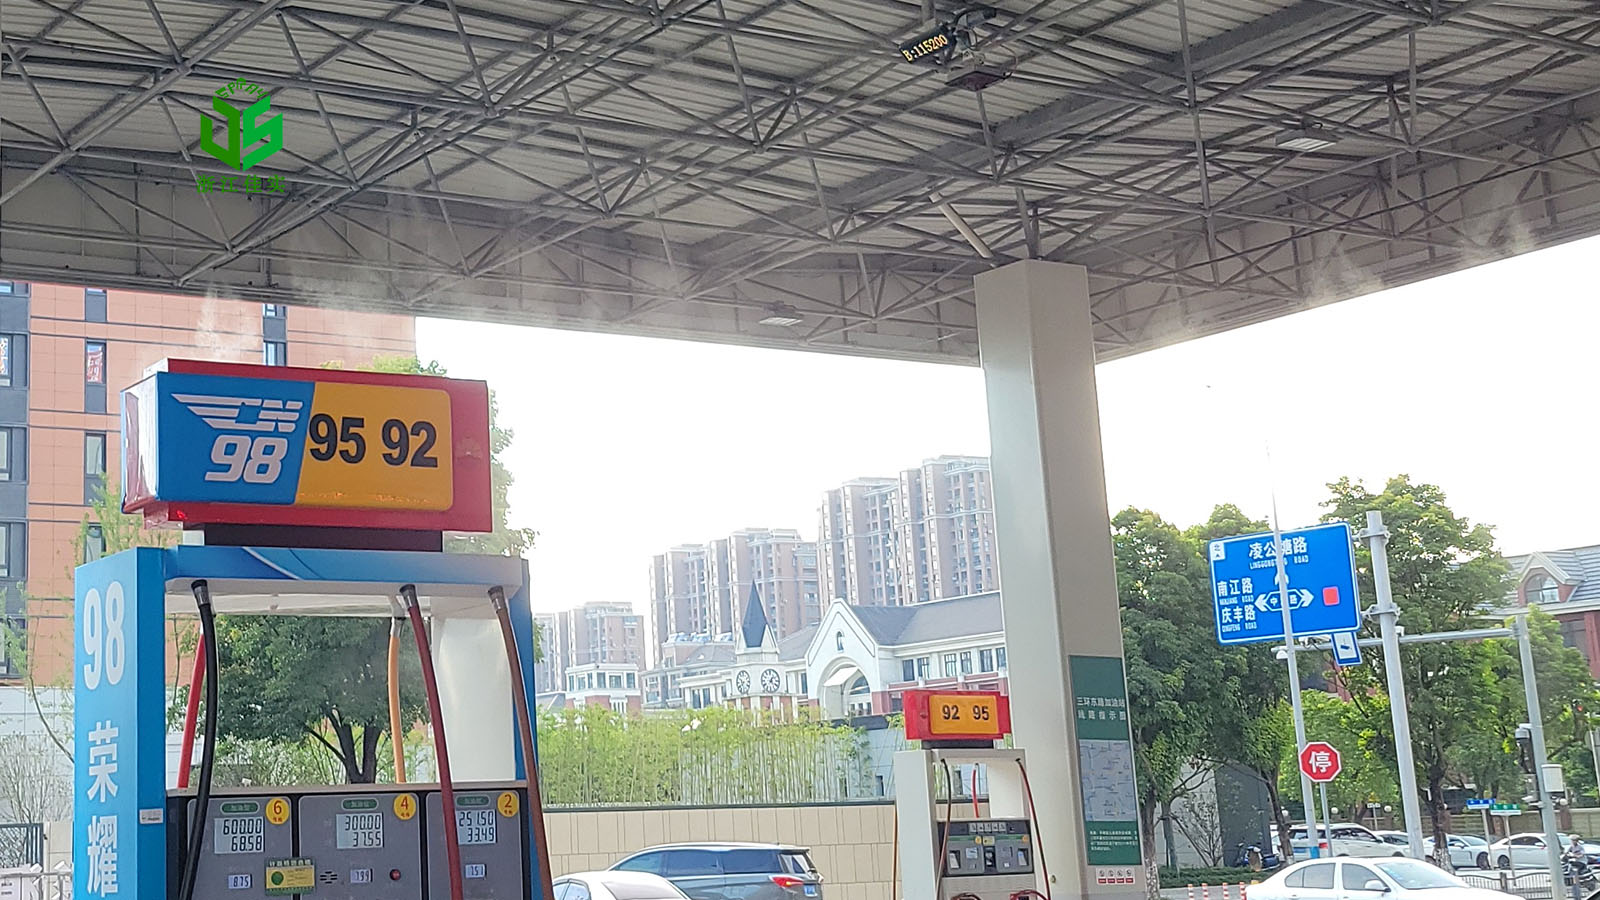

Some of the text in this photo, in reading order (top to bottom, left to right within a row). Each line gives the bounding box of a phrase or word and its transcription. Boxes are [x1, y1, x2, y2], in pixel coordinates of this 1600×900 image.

[903, 34, 948, 61] B:115200
[309, 413, 438, 468] 95 92
[204, 434, 288, 484] 98
[1294, 555, 1309, 563] ROAD
[1217, 577, 1253, 597] 南江路
[1242, 594, 1254, 602] ROAD
[1221, 604, 1256, 623] 庆丰路
[1245, 621, 1257, 629] ROAD
[83, 581, 126, 690] 98
[942, 704, 990, 721] 92 95
[1308, 750, 1333, 774] 停
[87, 720, 119, 898] 荣耀
[273, 800, 282, 815] 6
[400, 795, 409, 810] 4
[504, 793, 513, 808] 2
